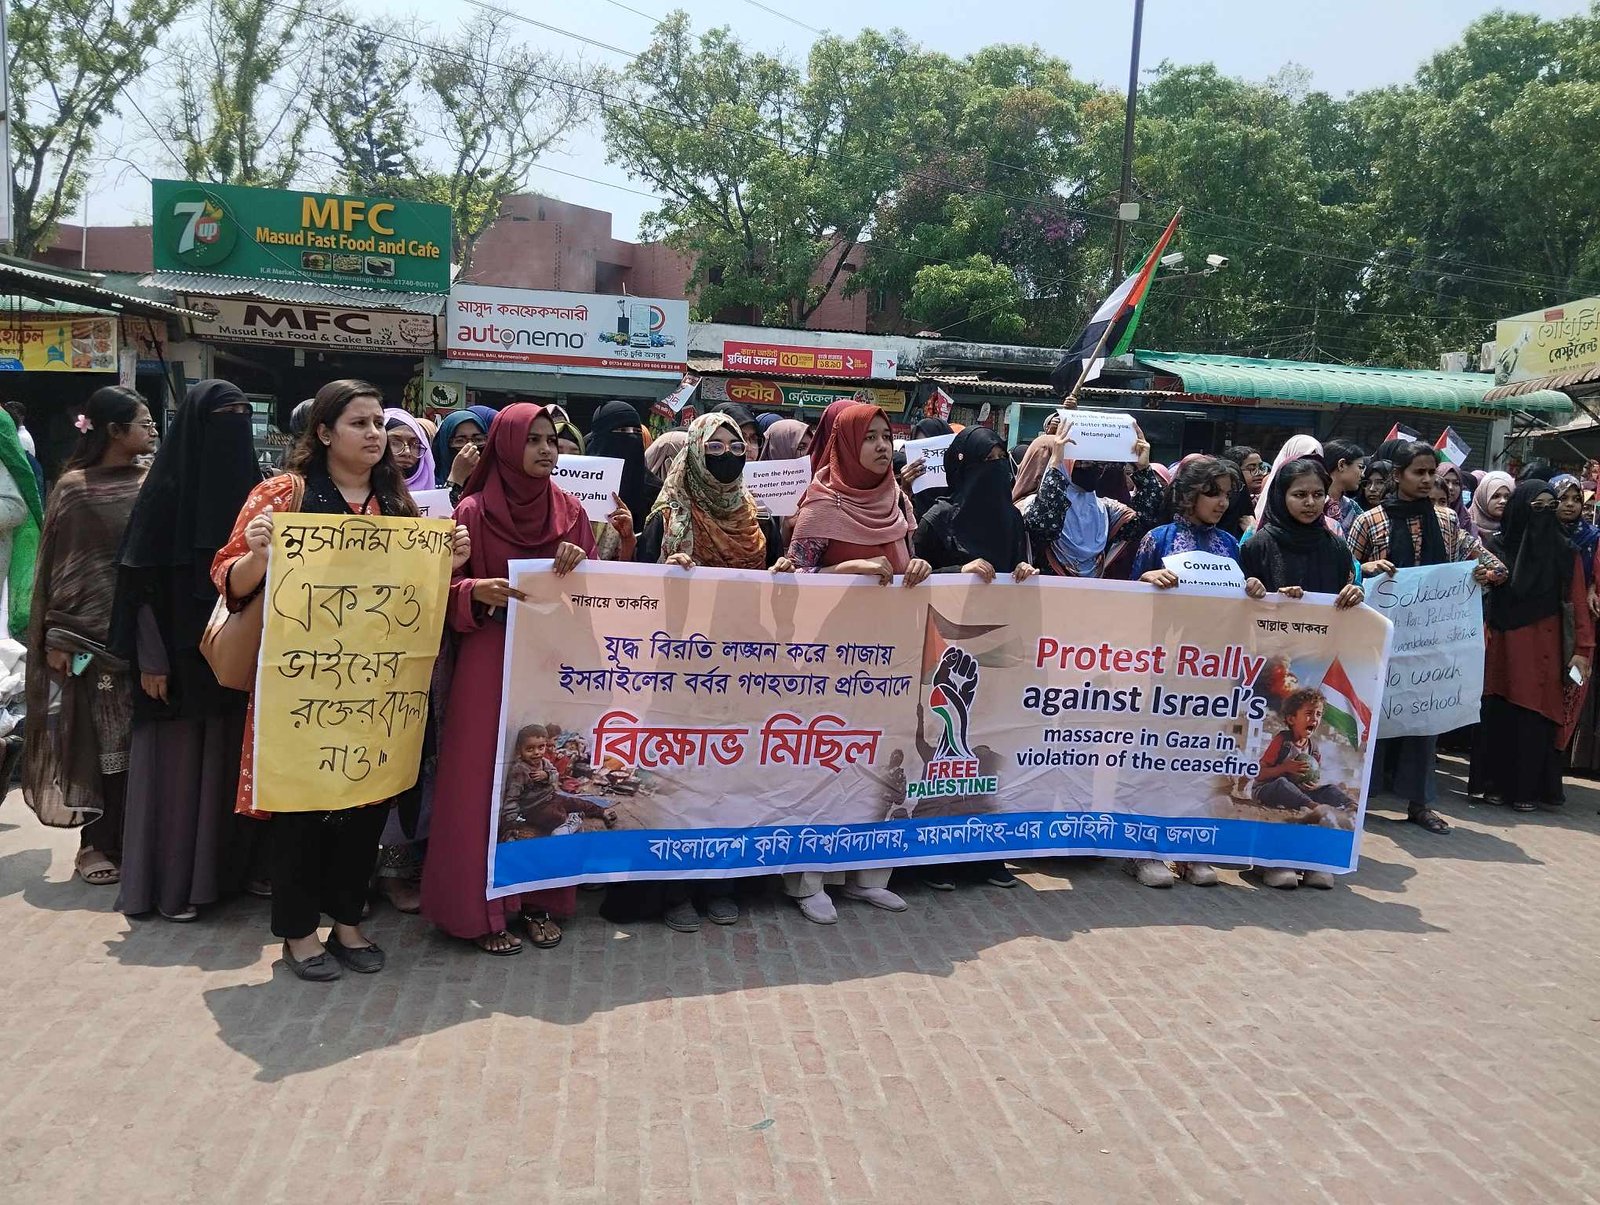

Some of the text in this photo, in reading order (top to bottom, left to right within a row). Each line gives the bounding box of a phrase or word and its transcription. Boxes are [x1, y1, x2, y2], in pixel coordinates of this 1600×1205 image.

[301, 196, 395, 235] MFC
[256, 226, 440, 259] Masud Fast Food and Cafe
[244, 304, 372, 335] MFC
[457, 301, 588, 321] মাসুদ কনফেকশনারী
[219, 325, 257, 337] Masud
[262, 328, 284, 339] Fast
[288, 331, 316, 341] Food
[321, 333, 330, 342] &
[334, 334, 361, 344] Cake
[366, 336, 398, 346] Bazar
[457, 324, 584, 350] autonemo
[727, 352, 777, 366] সুবিধা ডাবল
[782, 353, 798, 366] ৫০
[731, 380, 776, 402] কবীর
[788, 390, 833, 403] মেডিকেল
[1081, 431, 1121, 439] Netaneyahu!
[550, 465, 604, 480] Coward
[783, 469, 804, 477] Hyenas
[280, 518, 400, 565] মুসলিম
[1183, 561, 1231, 571] Coward
[571, 594, 659, 610] নারায়ে তাকবির
[1377, 573, 1477, 609] Solidarity
[1256, 619, 1329, 635] আল্লাহু আকবর
[604, 630, 895, 666] যুদ্ধ বিরতি লঙ্ঘন করে গাজায়
[1036, 637, 1266, 687] Protest Rally
[558, 660, 913, 698] ইসরাইলের বর্বর গণহত্যার প্রতিবাদে
[1023, 681, 1267, 721] against Israel’s
[1411, 685, 1462, 715] school
[592, 710, 882, 774] বিক্ষোভ মিছিল
[1043, 727, 1234, 750] massacre in Gaza in
[927, 760, 979, 779] FREE
[1016, 747, 1259, 777] violation of the ceasefire
[908, 777, 997, 798] PALESTINE
[648, 813, 1219, 866] বাংলাদেশ কৃষি বিশ্ববিদ্যালয়, ময়মনসিংহ-এর তৌহিদী ছাত্র জনতা
